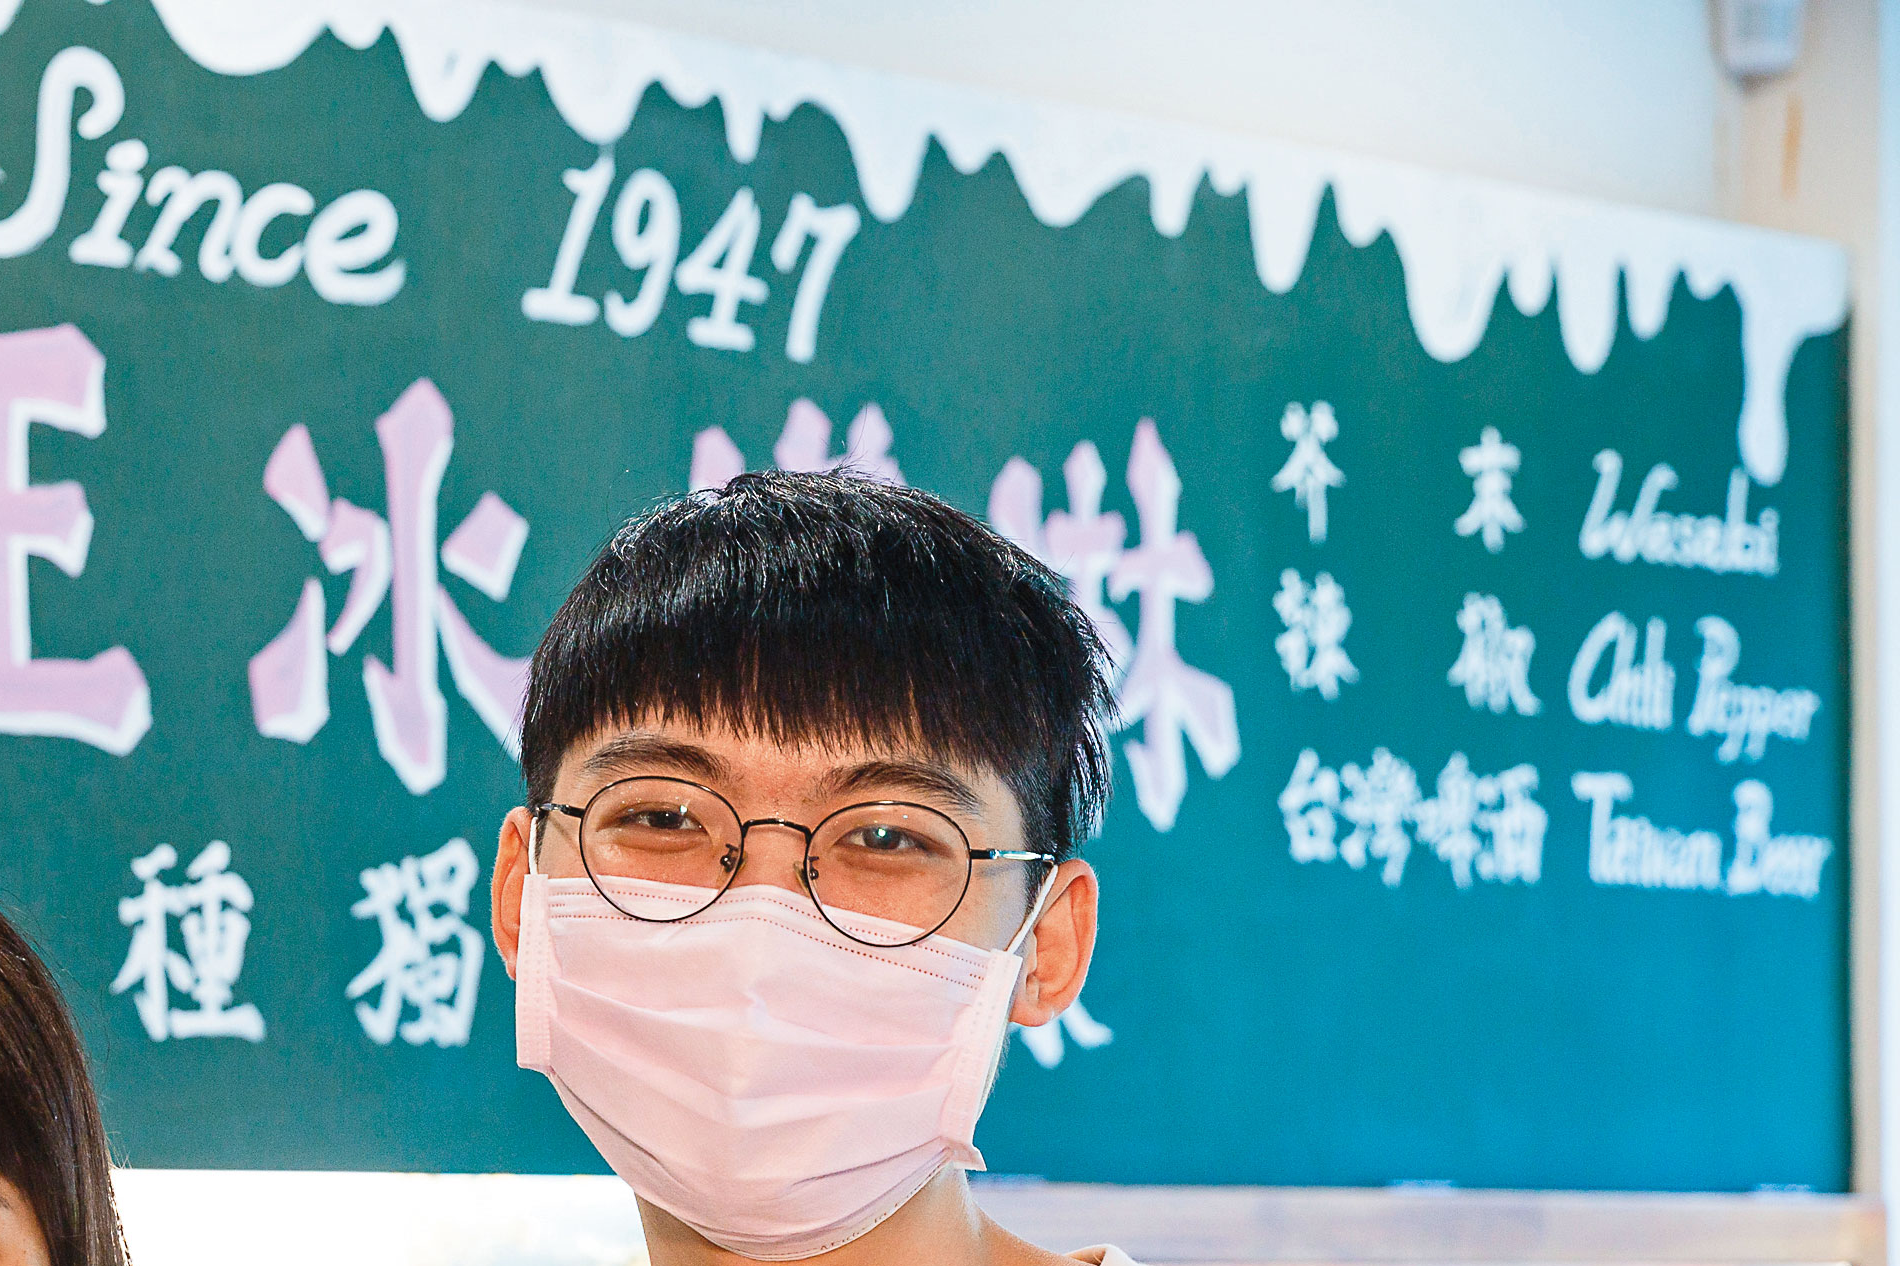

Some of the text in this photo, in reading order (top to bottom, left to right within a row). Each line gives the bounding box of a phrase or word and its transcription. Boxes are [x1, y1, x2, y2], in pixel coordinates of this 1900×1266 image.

[522, 152, 860, 363] 1947
[1580, 448, 1782, 577] Wasabi
[1686, 615, 1822, 764] Pepper
[1571, 771, 1723, 889] Taiwan
